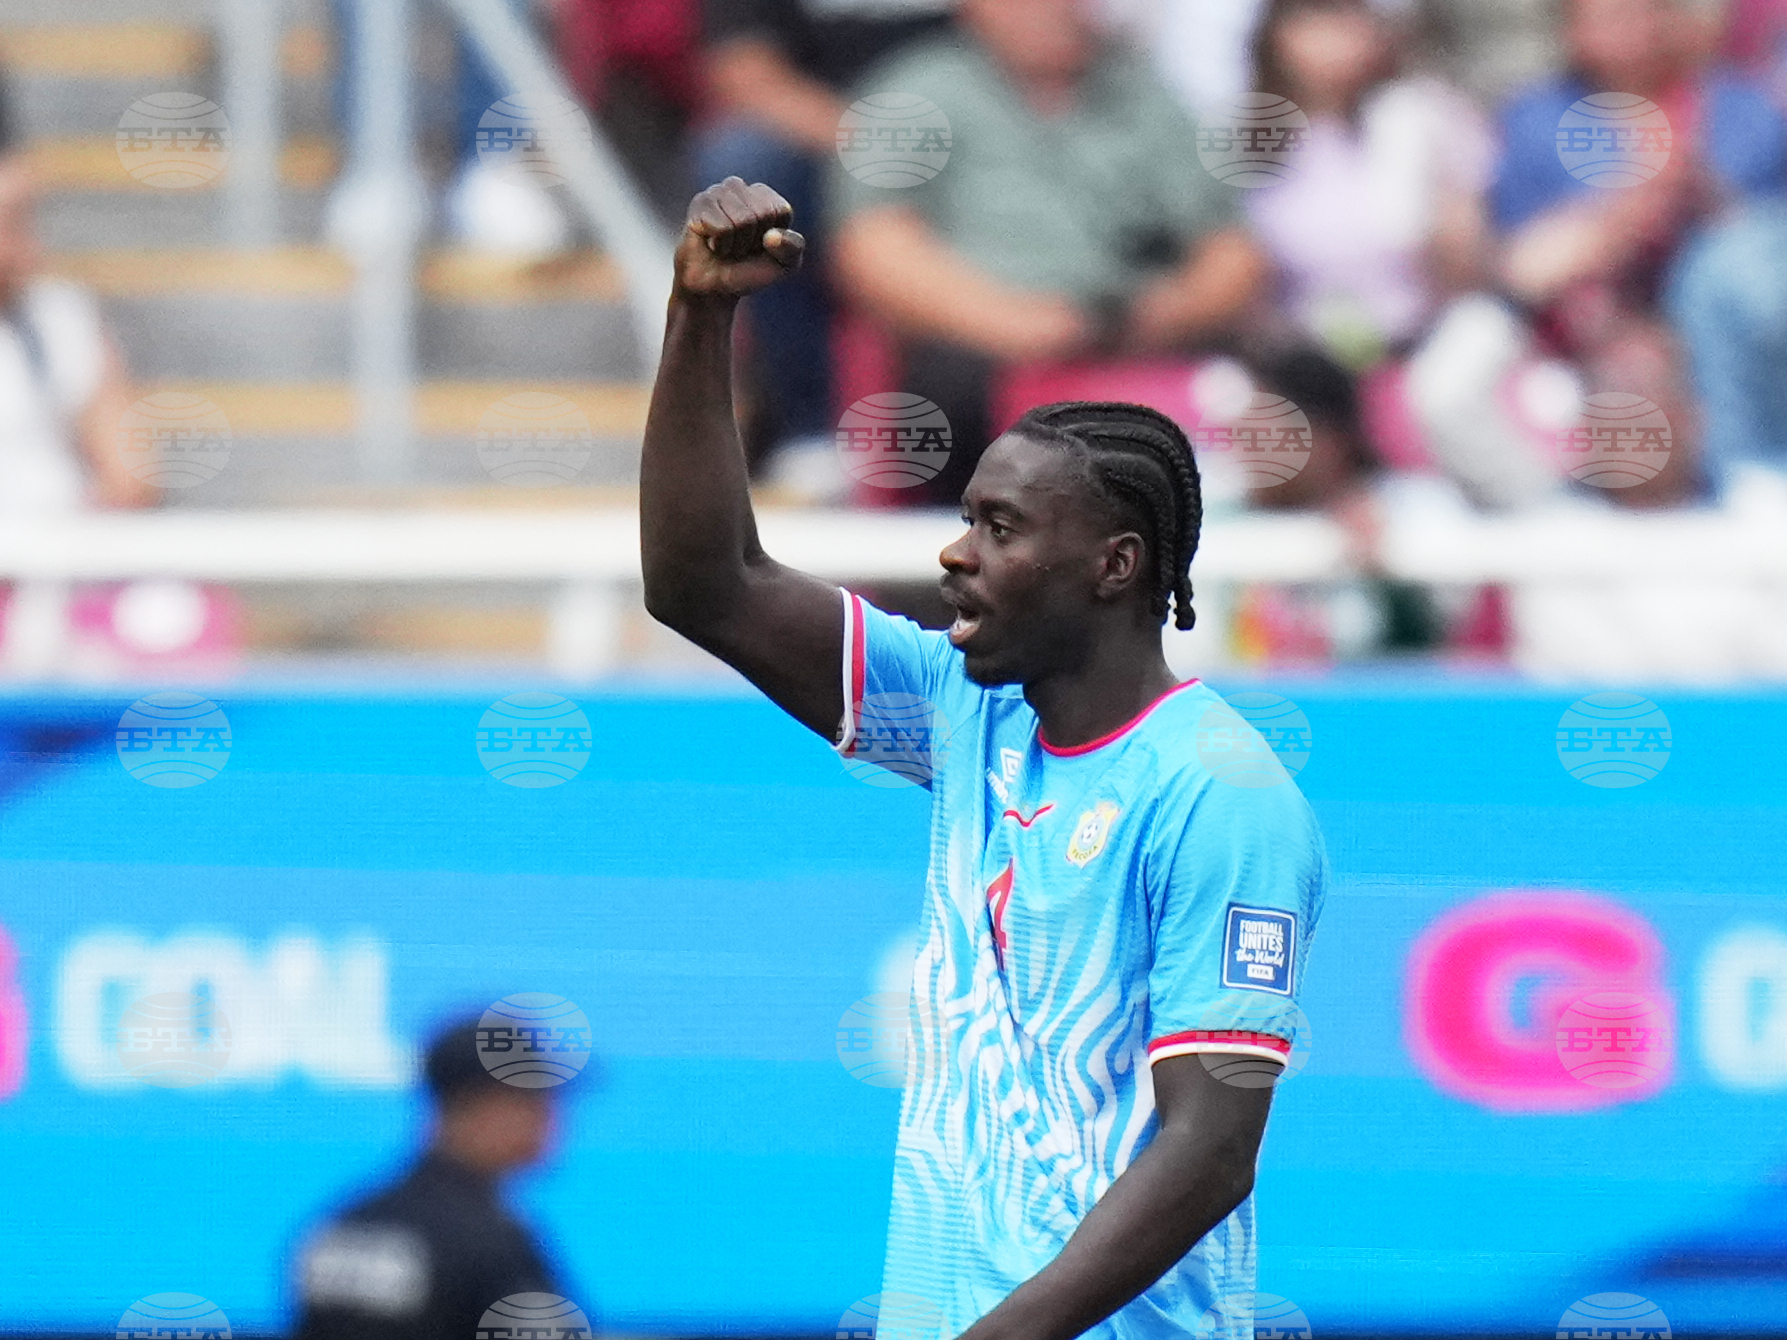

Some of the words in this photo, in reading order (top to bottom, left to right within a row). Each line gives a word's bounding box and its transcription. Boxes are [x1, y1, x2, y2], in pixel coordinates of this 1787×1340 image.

[1239, 918, 1284, 937] FOOTBALL
[1238, 931, 1284, 953] UNITES
[1250, 967, 1270, 977] FIFA
